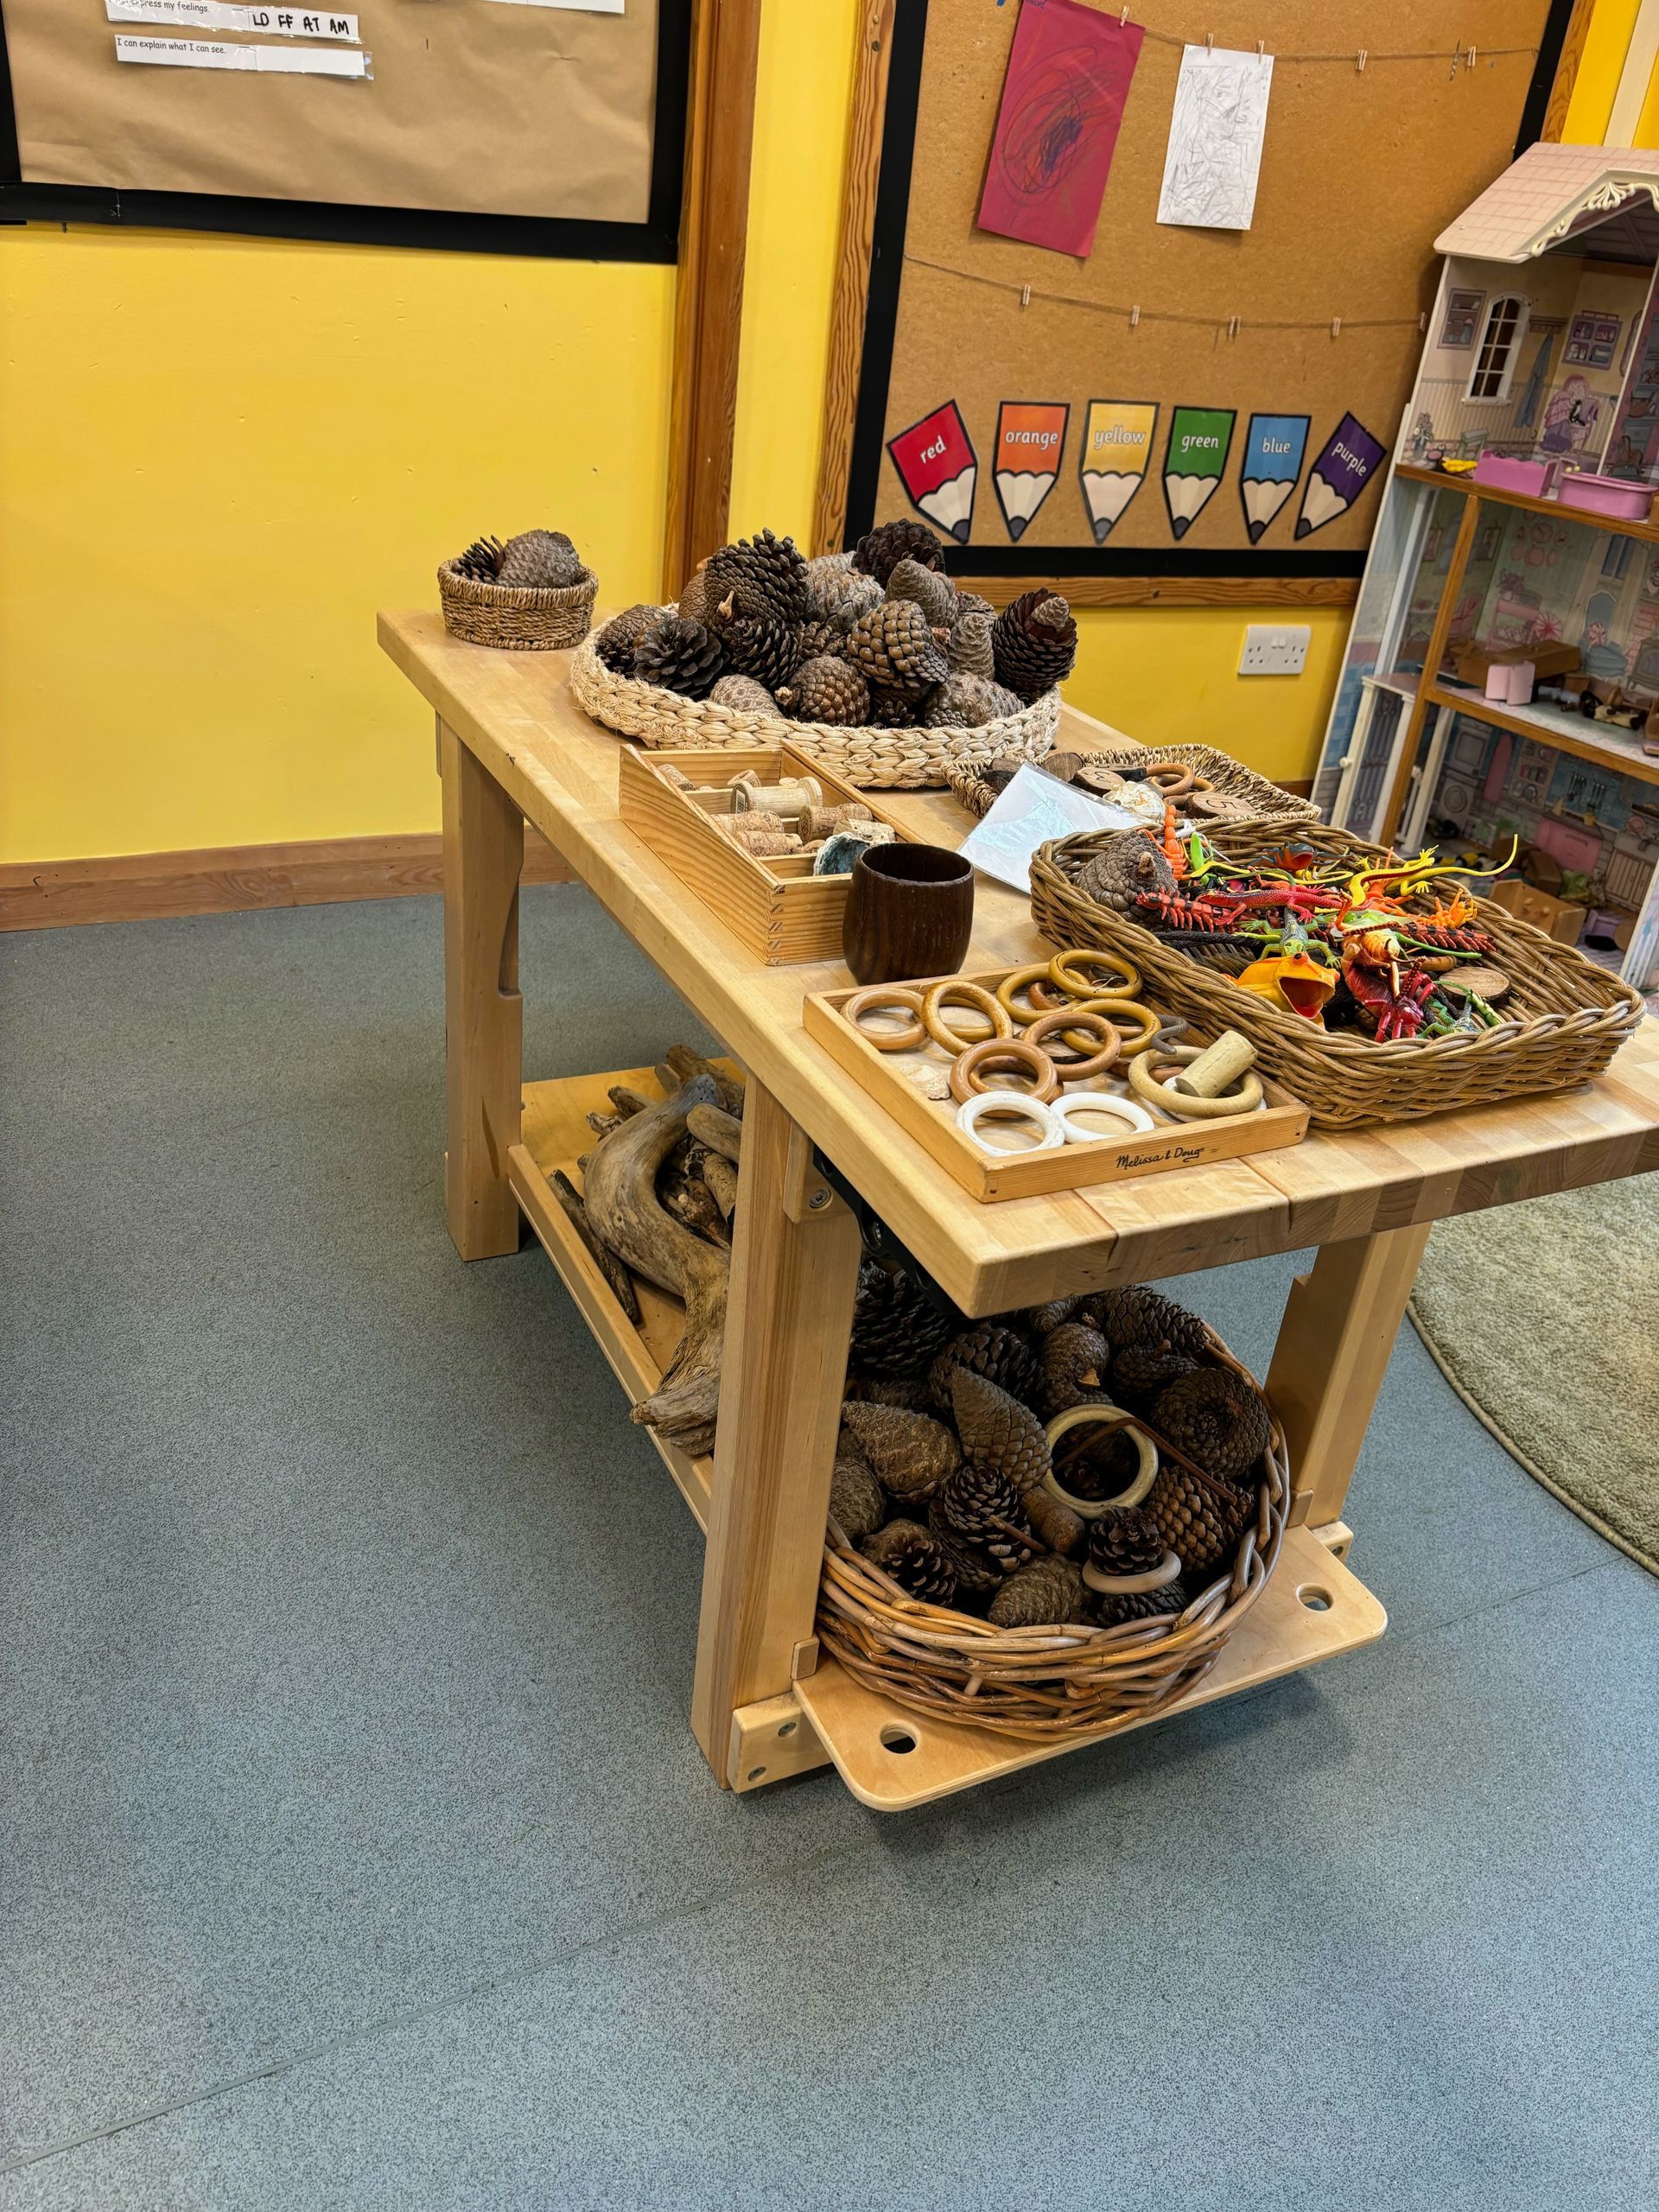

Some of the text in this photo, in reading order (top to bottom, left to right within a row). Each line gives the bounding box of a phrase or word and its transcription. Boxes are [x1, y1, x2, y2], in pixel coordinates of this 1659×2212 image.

[164, 2, 175, 10] my
[277, 14, 293, 29] FF
[303, 16, 320, 32] AT
[329, 18, 349, 35] AM
[139, 41, 167, 50] explain
[168, 42, 187, 51] what
[1004, 430, 1058, 451] orange
[1094, 425, 1147, 450] yellow
[1181, 434, 1219, 453] green
[1262, 436, 1291, 454] blue
[919, 435, 947, 464] red
[1331, 441, 1367, 477] purple
[1116, 1153, 1164, 1170] Melissa
[1174, 1147, 1205, 1163] Doug
